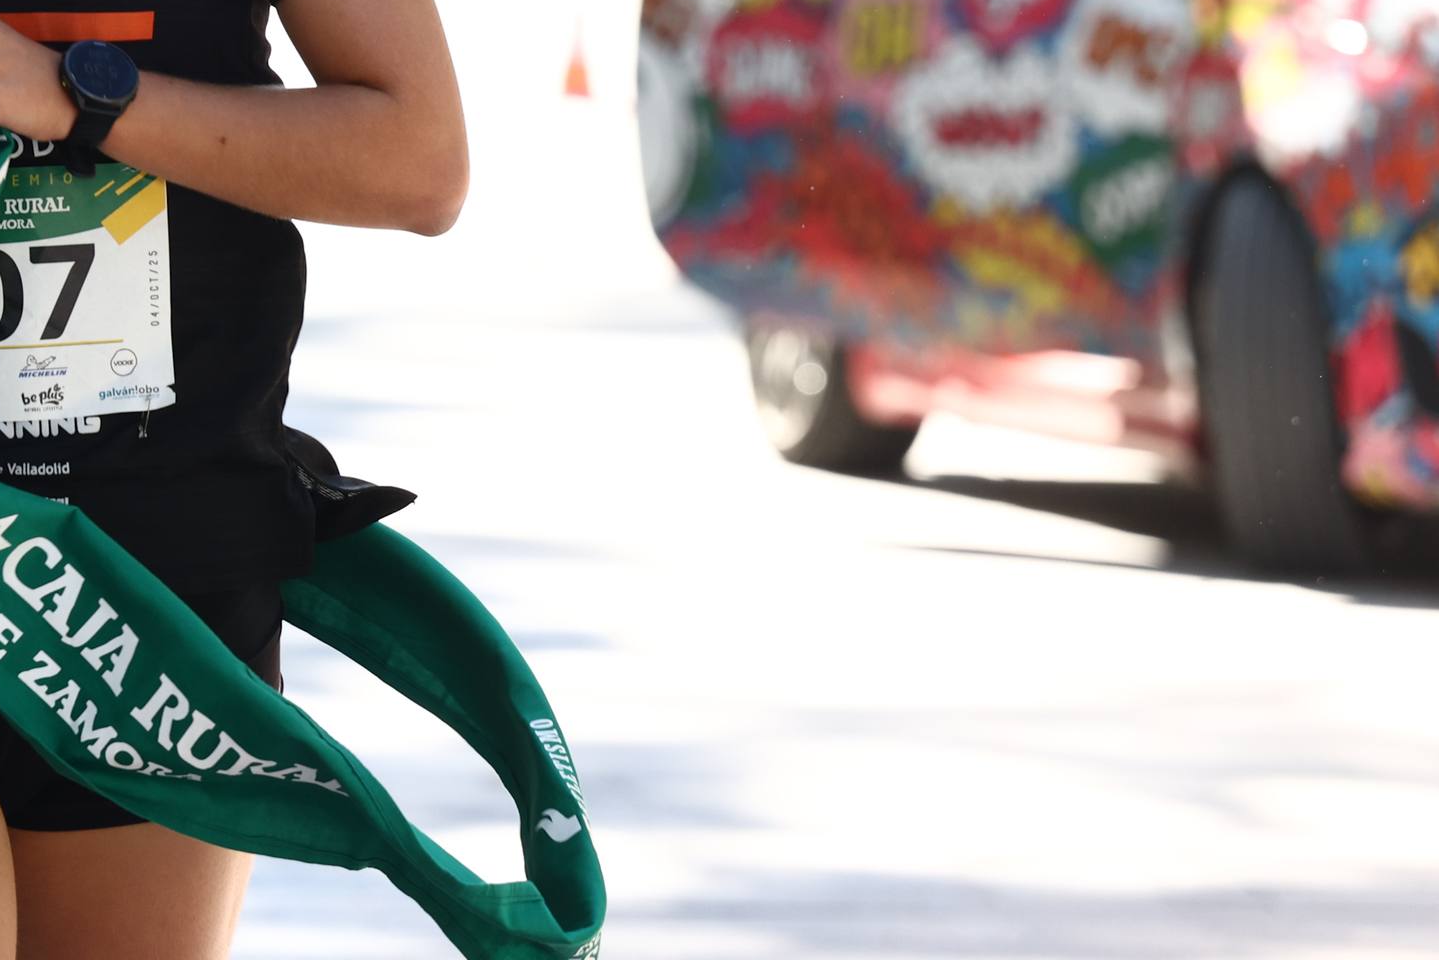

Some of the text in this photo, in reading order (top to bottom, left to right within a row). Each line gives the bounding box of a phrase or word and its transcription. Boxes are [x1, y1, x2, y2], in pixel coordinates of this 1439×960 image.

[12, 172, 73, 187] EMIO
[4, 196, 71, 215] RURAL
[148, 250, 160, 327] 04/OCT/25
[18, 370, 67, 379] MICHELIN
[21, 386, 64, 405] be plus
[7, 462, 71, 476] Valladolid
[2, 537, 351, 797] CAJA RURAL
[17, 651, 202, 782] ZAMORA
